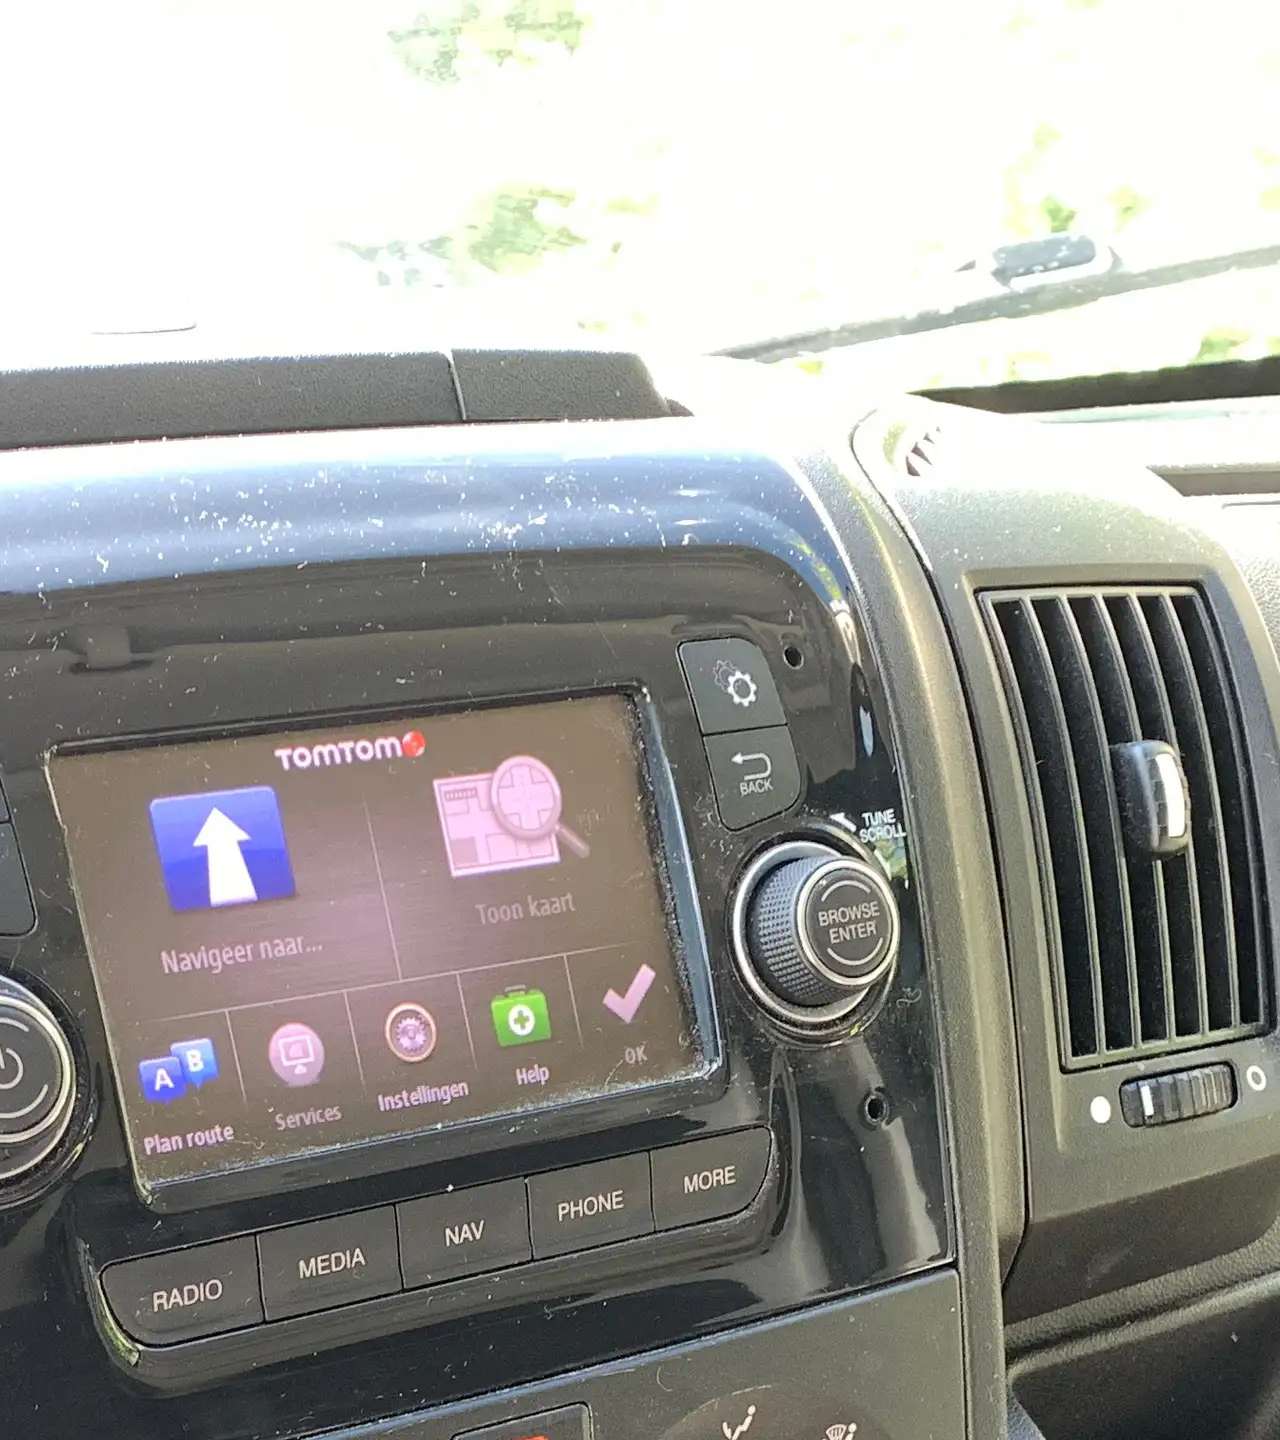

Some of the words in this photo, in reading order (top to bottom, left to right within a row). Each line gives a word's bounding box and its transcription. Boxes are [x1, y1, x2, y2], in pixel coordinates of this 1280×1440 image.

[275, 737, 403, 771] TOMTOM
[739, 778, 773, 796] BACK
[862, 808, 897, 828] TUNE
[859, 822, 907, 844] SCROLL
[476, 901, 524, 925] Toon
[529, 891, 576, 919] kaart
[817, 902, 880, 928] BROWSE
[828, 921, 877, 944] ENTER
[161, 941, 253, 976] Navigeer
[259, 934, 323, 961] naar...
[187, 1050, 205, 1073] B
[624, 1044, 648, 1066] OK
[153, 1067, 174, 1090] A
[516, 1063, 550, 1087] Help
[378, 1079, 469, 1113] Instellingen
[275, 1104, 342, 1131] Services
[144, 1131, 187, 1155] Plan
[192, 1123, 234, 1147] route
[682, 1165, 736, 1194] MORE
[556, 1190, 624, 1222] PHONE
[444, 1220, 486, 1247] NAV
[297, 1247, 366, 1280] MEDIA
[152, 1279, 223, 1313] RADIO
